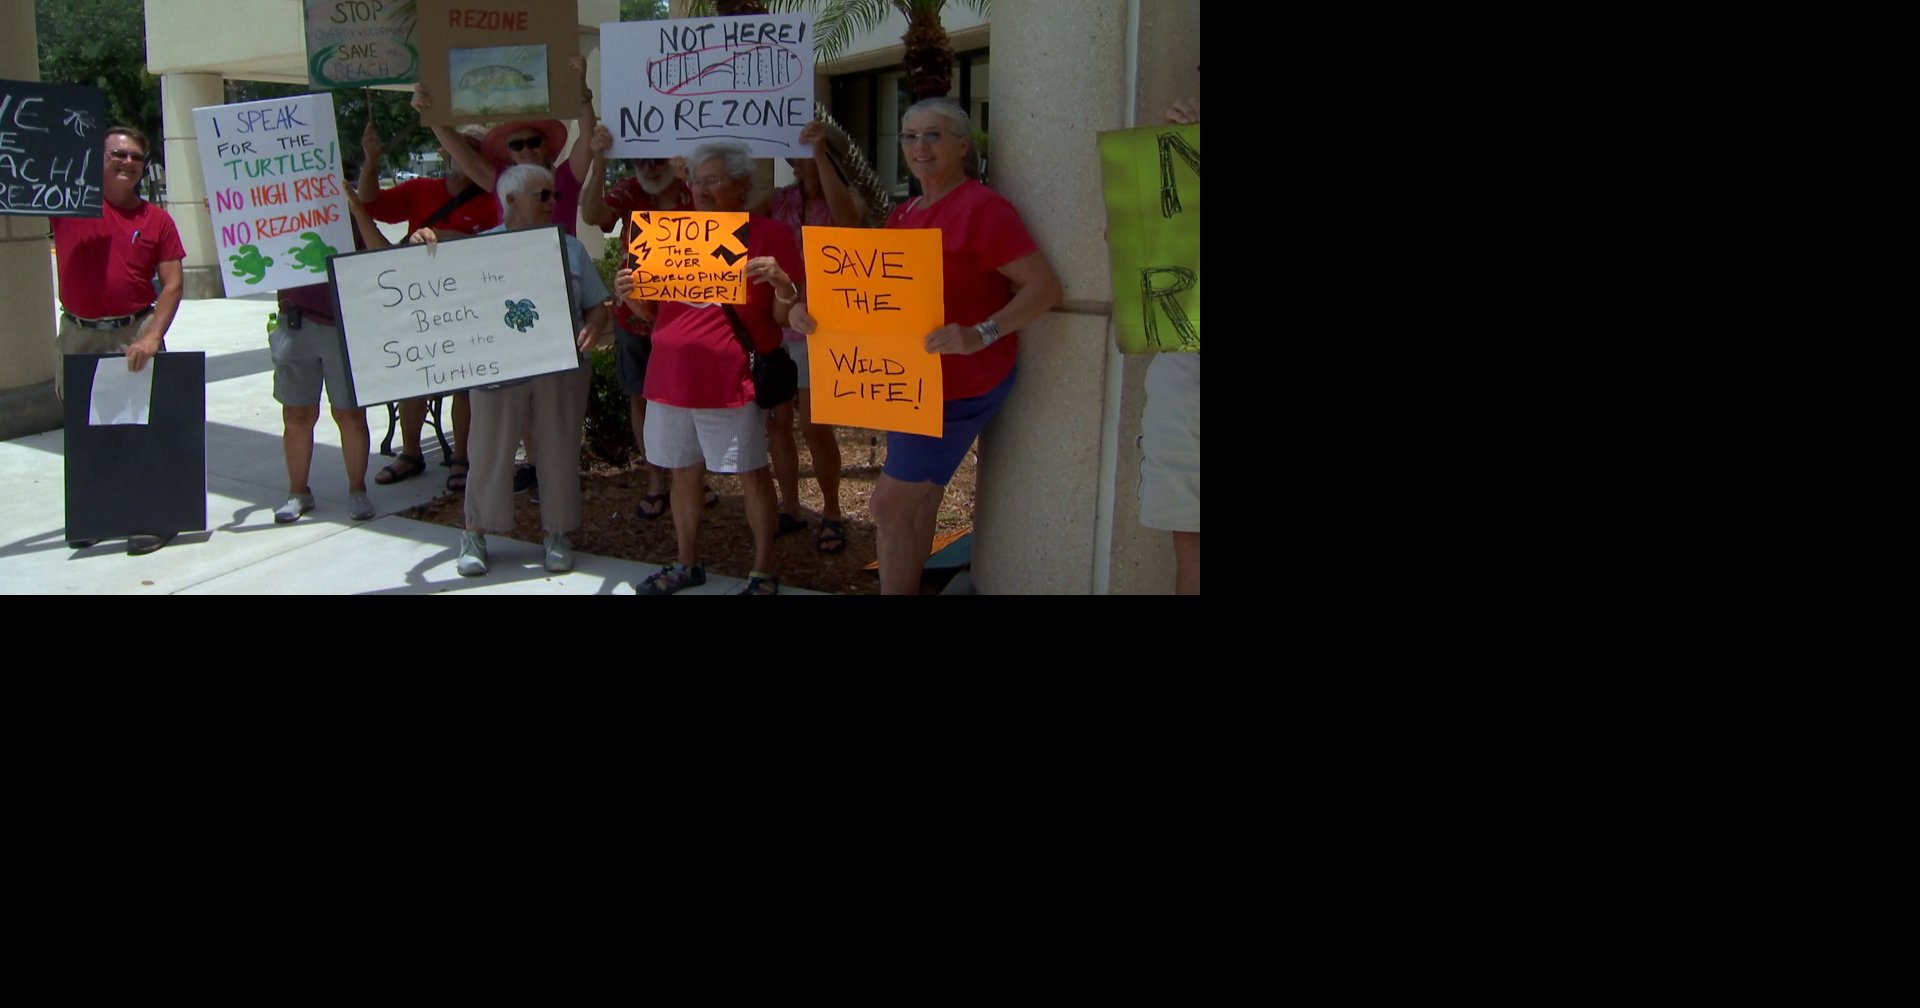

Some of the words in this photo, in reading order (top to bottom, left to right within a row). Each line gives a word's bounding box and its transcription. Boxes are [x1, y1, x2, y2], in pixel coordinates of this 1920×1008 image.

[330, 0, 383, 24] STOP
[449, 8, 528, 31] REZONE
[660, 23, 715, 54] NOT
[723, 19, 806, 54] HERE!
[338, 42, 379, 61] SAVE
[333, 61, 389, 81] BEACH
[212, 117, 221, 138] I
[236, 105, 307, 134] SPEAK
[620, 100, 665, 138] NO
[674, 96, 806, 132] REZONE
[217, 140, 257, 158] FOR
[276, 134, 314, 151] THE
[223, 141, 335, 181] TURTLES!
[216, 187, 244, 214] NO
[250, 182, 288, 208] HIGH
[294, 173, 340, 204] RISES
[222, 221, 252, 249] NO
[255, 204, 340, 241] REZONING
[655, 216, 720, 242] STOP
[658, 245, 700, 256] THE
[664, 258, 701, 268] OVER
[821, 245, 913, 280] SAVE
[377, 269, 458, 308] Save
[480, 271, 506, 283] the
[636, 285, 738, 301] DANGER!
[832, 288, 901, 314] THE
[410, 305, 479, 333] Beach
[383, 338, 456, 369] Save
[468, 333, 495, 345] the
[829, 346, 905, 375] WILD
[416, 360, 500, 389] Turtles
[833, 377, 923, 410] LIFE!
